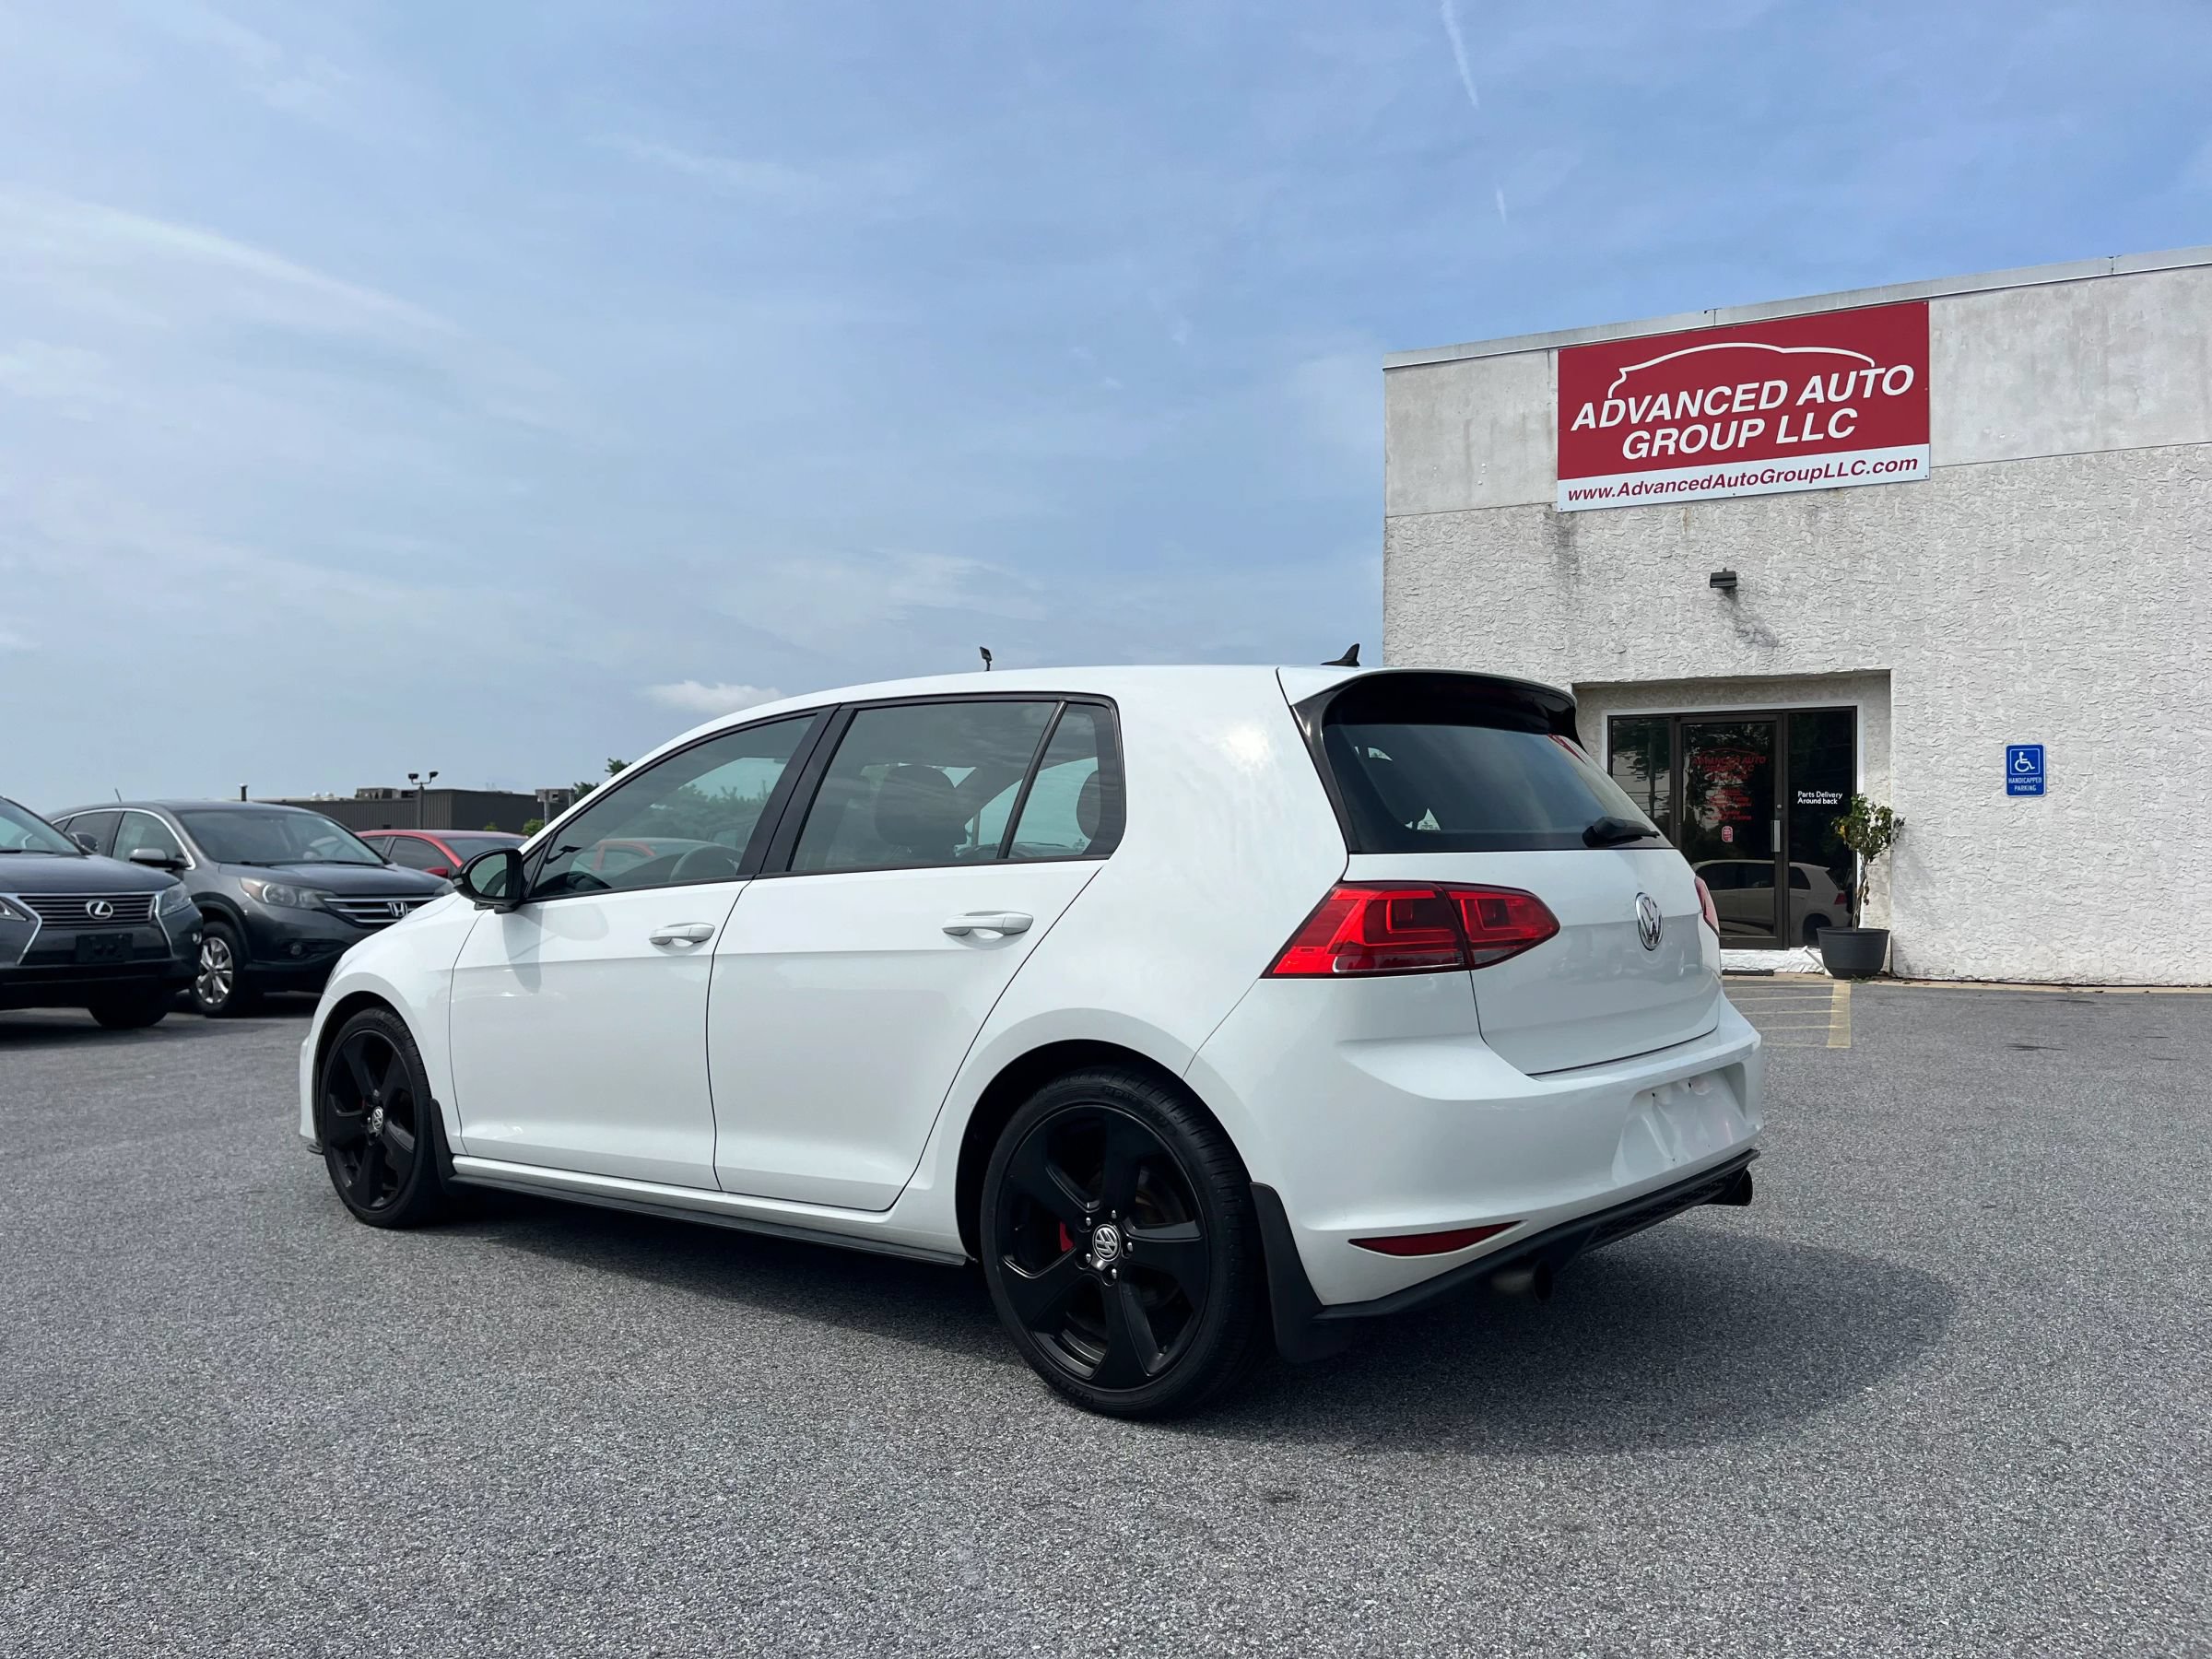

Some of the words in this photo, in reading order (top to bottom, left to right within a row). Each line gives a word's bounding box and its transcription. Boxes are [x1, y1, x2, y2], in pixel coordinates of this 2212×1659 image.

[1570, 379, 1788, 430] ADVANCED
[1795, 364, 1914, 406] AUTO
[1622, 418, 1766, 460] GROUP
[1775, 407, 1858, 444] LLC
[1568, 455, 1918, 501] www.AdvancedAutoGroupLLC.com
[1797, 790, 1815, 798] Parts
[1816, 790, 1843, 800] Delivery
